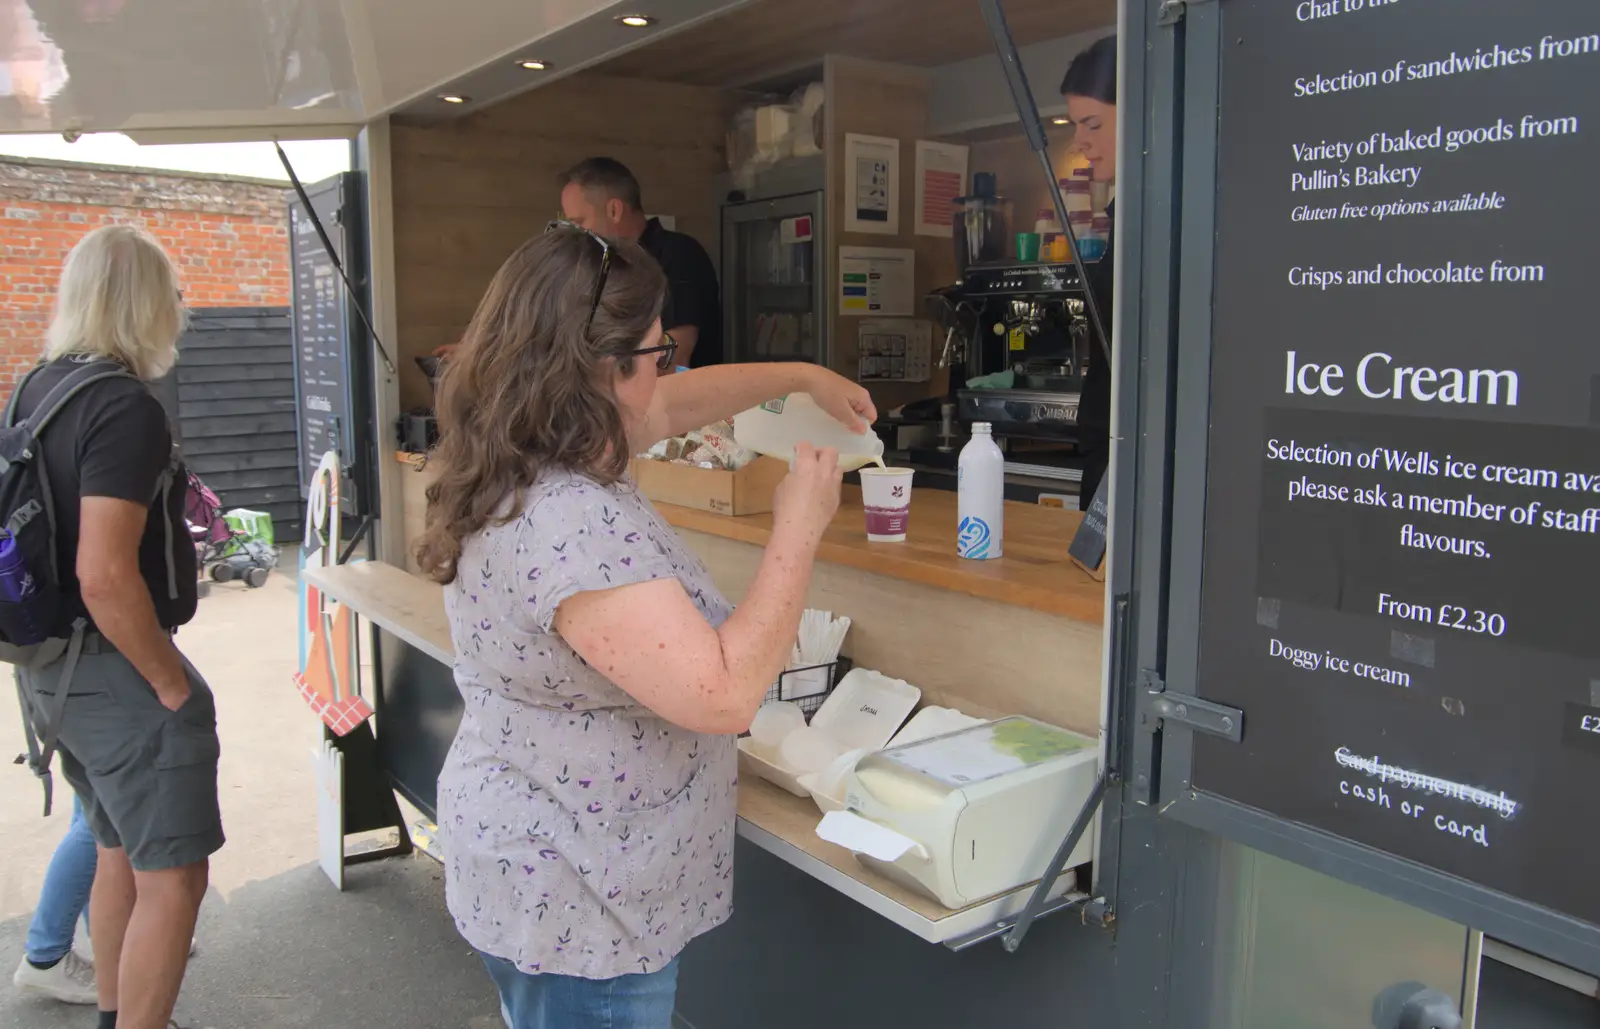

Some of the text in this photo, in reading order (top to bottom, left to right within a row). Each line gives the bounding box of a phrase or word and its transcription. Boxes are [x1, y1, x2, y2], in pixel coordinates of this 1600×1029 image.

[1296, 0, 1340, 21] Chat
[1294, 35, 1599, 97] Selection of sandwiches from
[1292, 115, 1577, 163] Variety of baked goods from
[1356, 164, 1421, 188] Bakery
[1291, 191, 1505, 222] Gluten free options available
[1288, 260, 1544, 290] Crisps and chocolate from
[1285, 351, 1518, 406] Ice Cream
[1267, 439, 1352, 468] Selection
[1357, 447, 1383, 470] of
[1384, 450, 1439, 476] Wells
[1444, 455, 1477, 480] ice
[1482, 464, 1557, 489] cream
[1288, 475, 1600, 533] please ask a member of staff
[1400, 523, 1491, 558] flavours.
[1377, 592, 1506, 637] From £2.30
[1269, 639, 1411, 688] Doggy ice cream
[1339, 780, 1489, 847] cash or card
